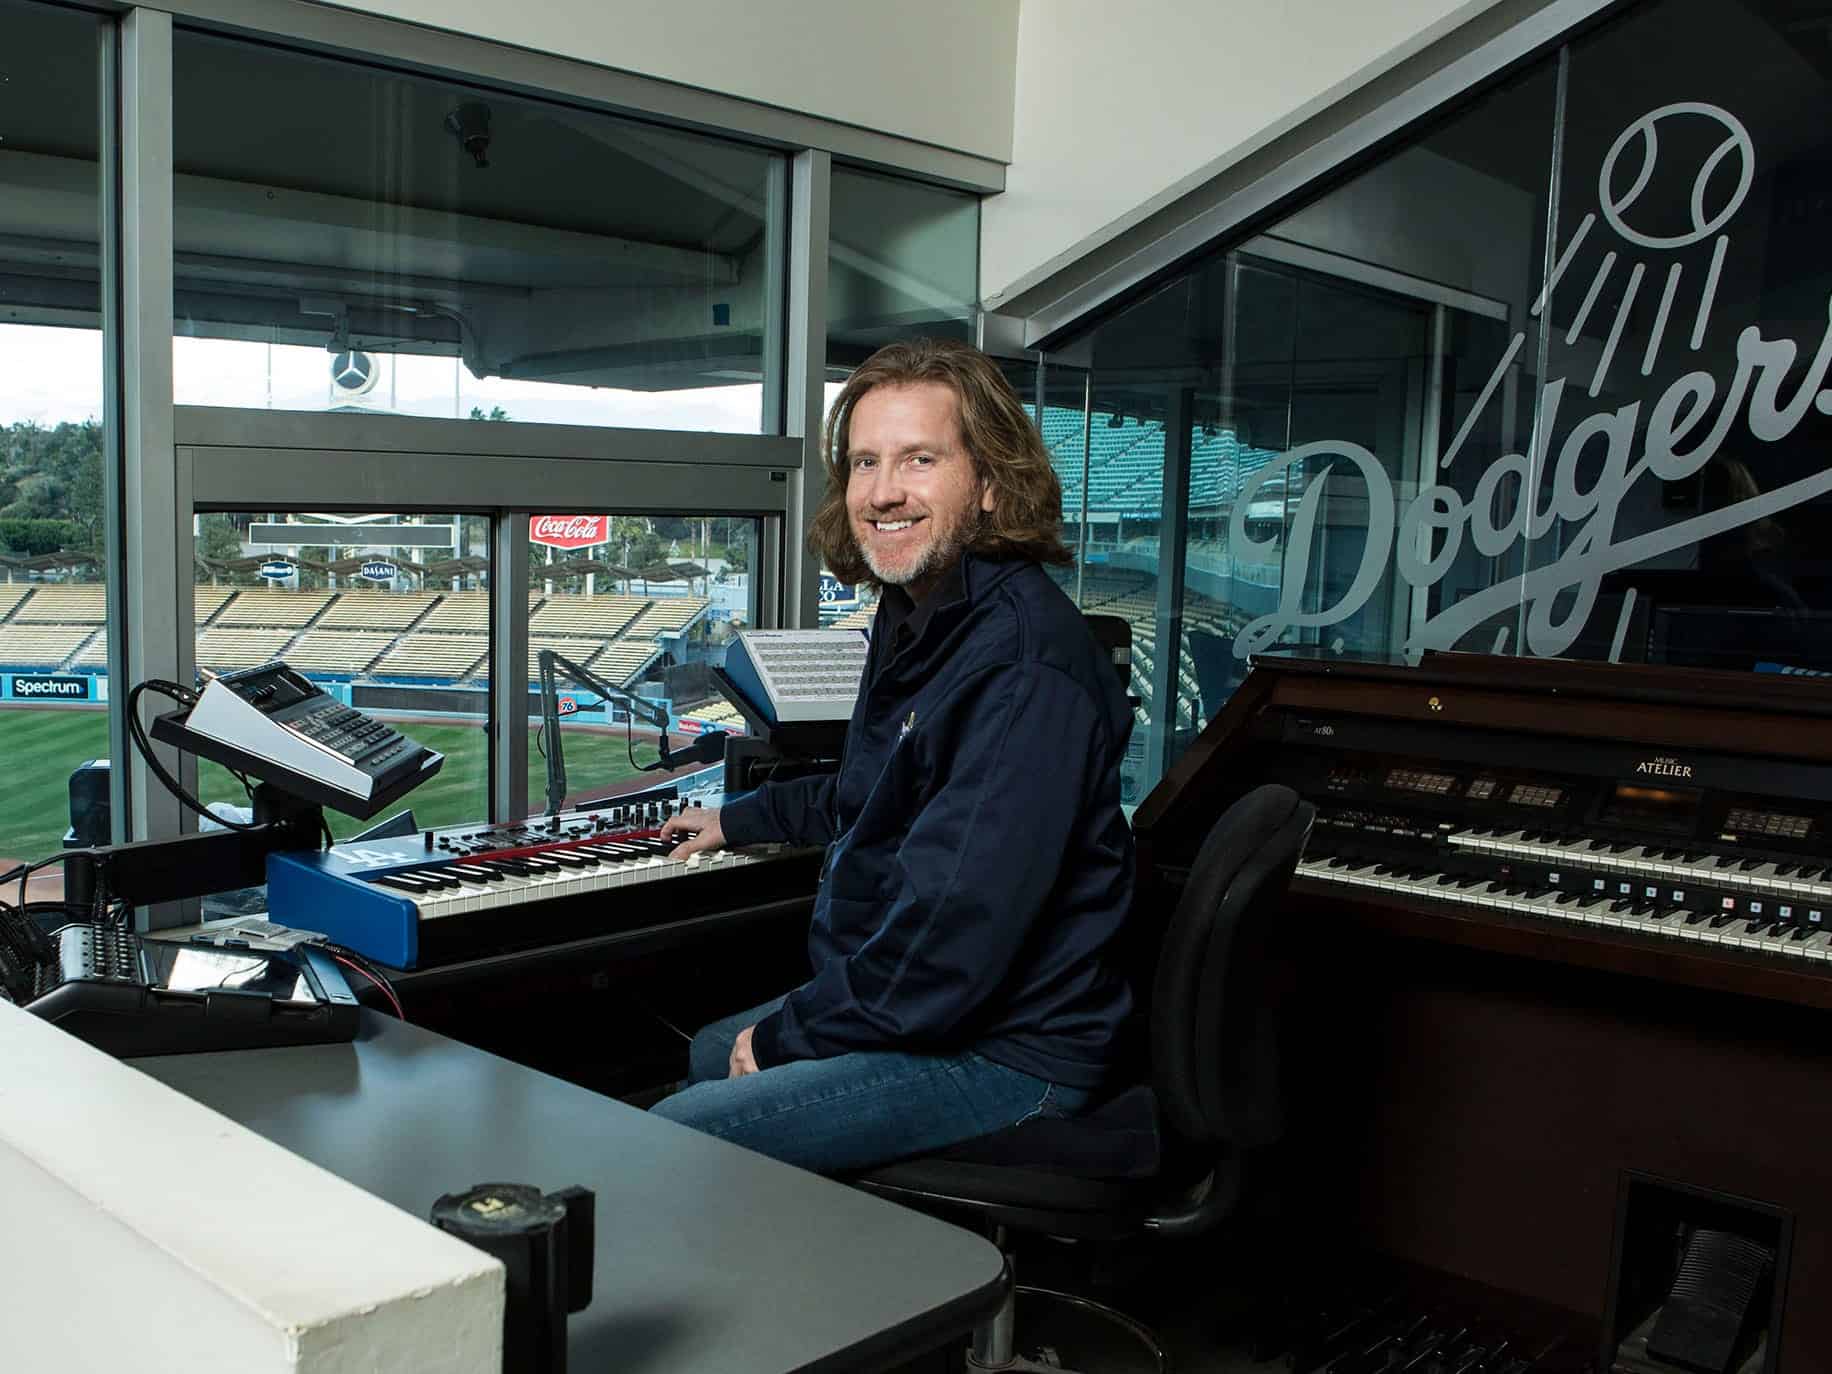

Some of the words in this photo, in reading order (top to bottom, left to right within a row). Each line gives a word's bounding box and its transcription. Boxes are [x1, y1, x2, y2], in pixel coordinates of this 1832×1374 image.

[363, 566, 394, 576] DASANI
[15, 679, 80, 695] Spectrum
[562, 702, 574, 712] 76
[1636, 762, 1692, 778] ATELIER
